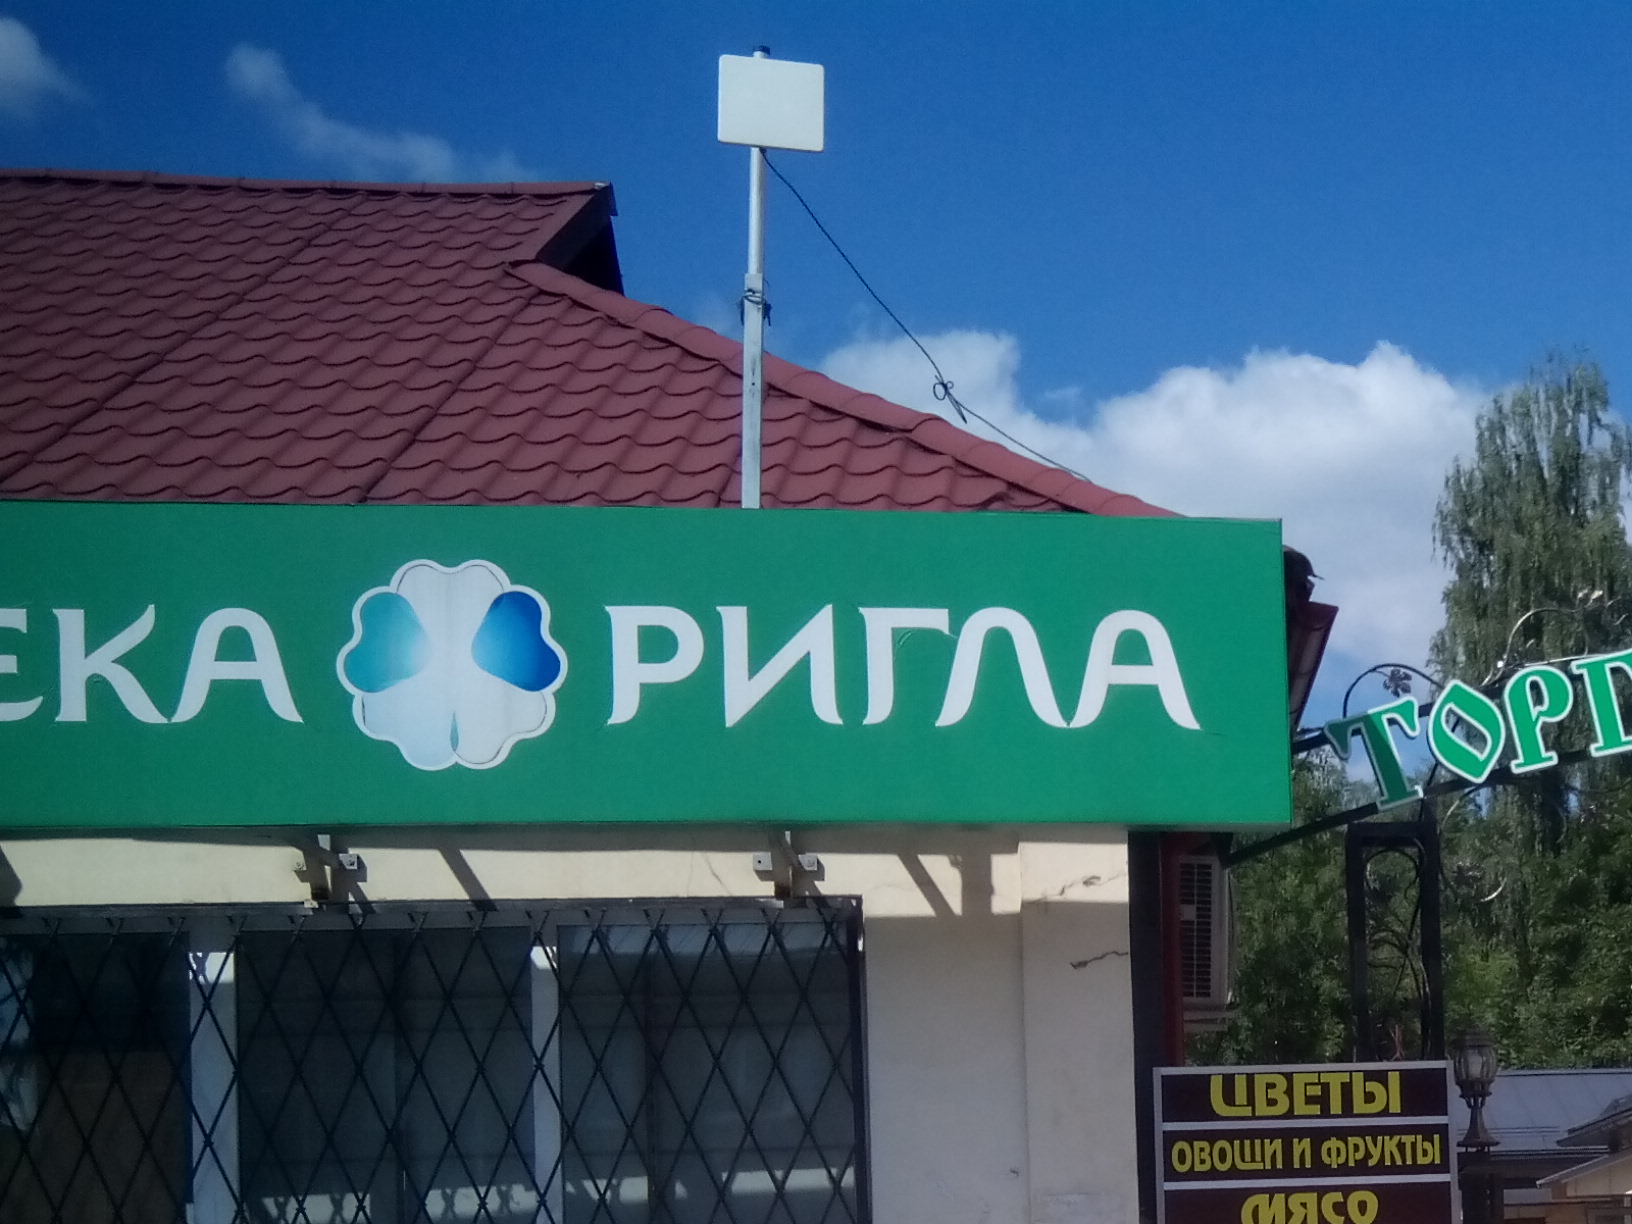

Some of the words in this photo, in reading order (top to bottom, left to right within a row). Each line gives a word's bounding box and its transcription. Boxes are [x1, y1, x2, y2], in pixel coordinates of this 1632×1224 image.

[605, 603, 1202, 731] РИГЛА
[1210, 1071, 1401, 1117] ЦВЕТЫ
[1171, 1138, 1283, 1173] ОВОЩИ
[1292, 1137, 1311, 1169] И
[1321, 1134, 1441, 1169] ФРУКТЫ
